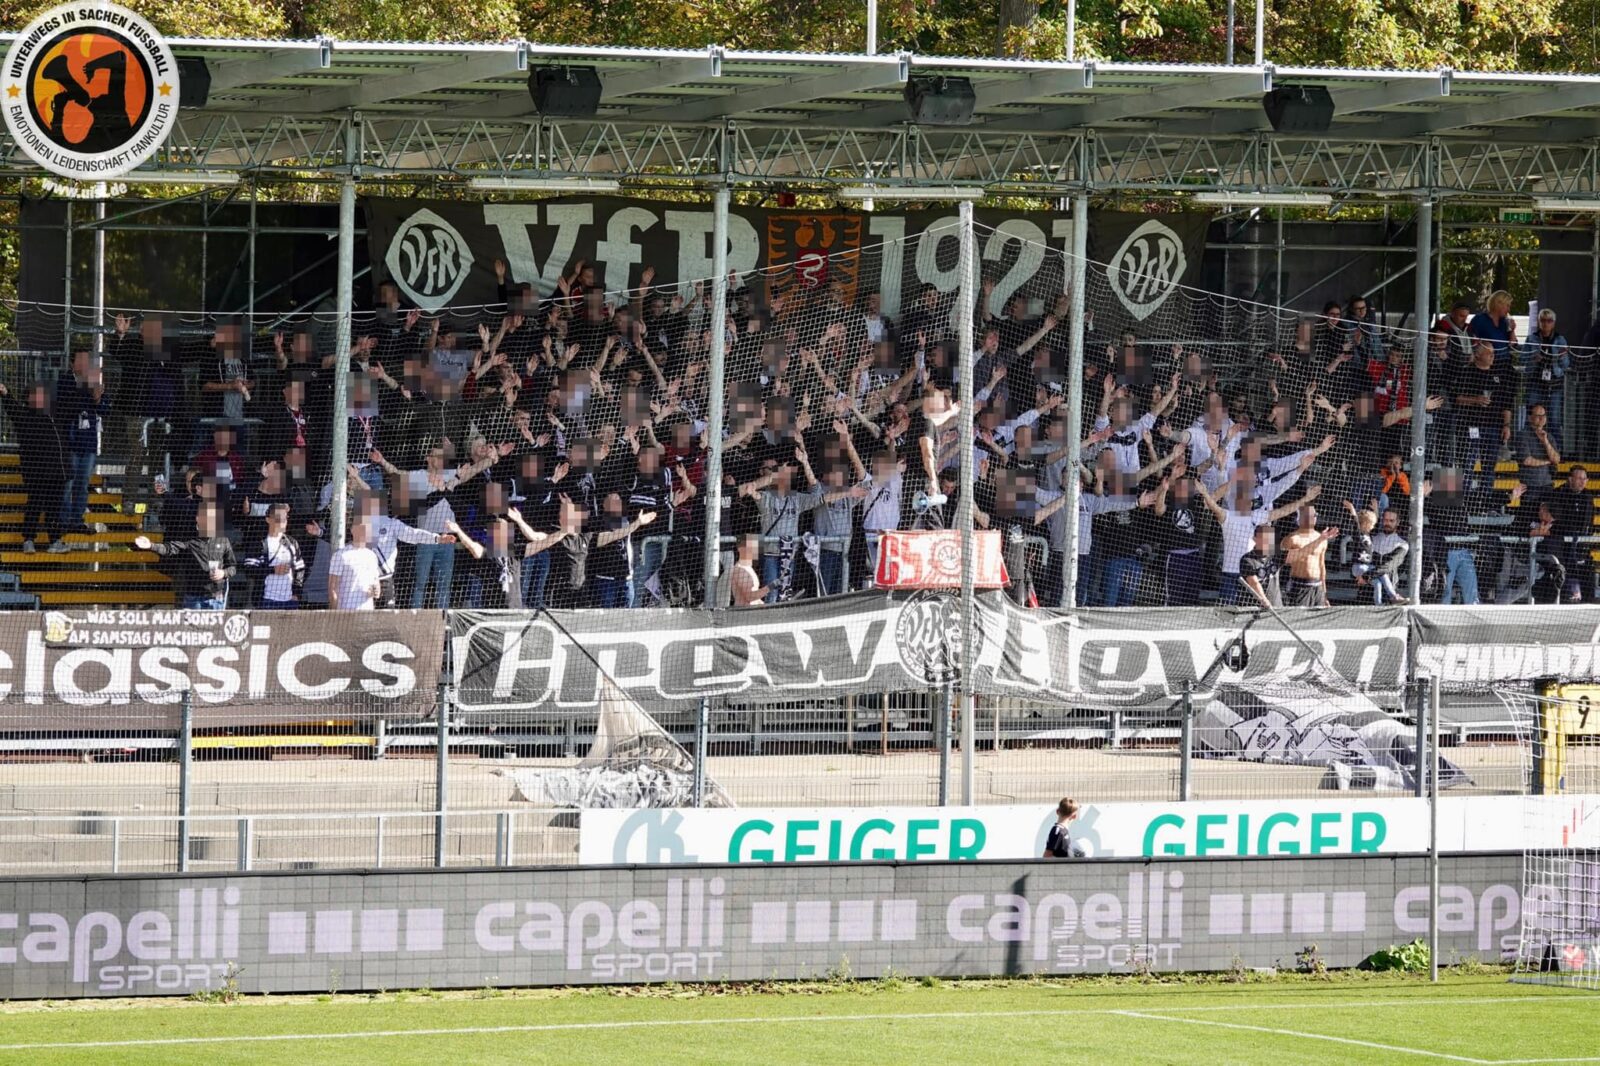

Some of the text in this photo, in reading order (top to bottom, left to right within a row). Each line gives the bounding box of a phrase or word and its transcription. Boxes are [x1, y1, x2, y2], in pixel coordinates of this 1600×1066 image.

[484, 203, 760, 312] VfR
[68, 630, 89, 644] AM
[93, 630, 150, 645] SAMSTAG
[119, 610, 149, 625] SOLL
[153, 611, 181, 625] MAN
[184, 612, 224, 625] SONST
[0, 626, 416, 708] lassics
[1577, 695, 1591, 729] 9
[729, 817, 987, 863] GEIGER
[1141, 811, 1388, 857] GEIGER
[474, 876, 726, 970] capelli
[946, 870, 1185, 961] capelli
[591, 951, 723, 978] SPORT
[1056, 943, 1182, 968] SPORT
[98, 963, 237, 991] SPORT
